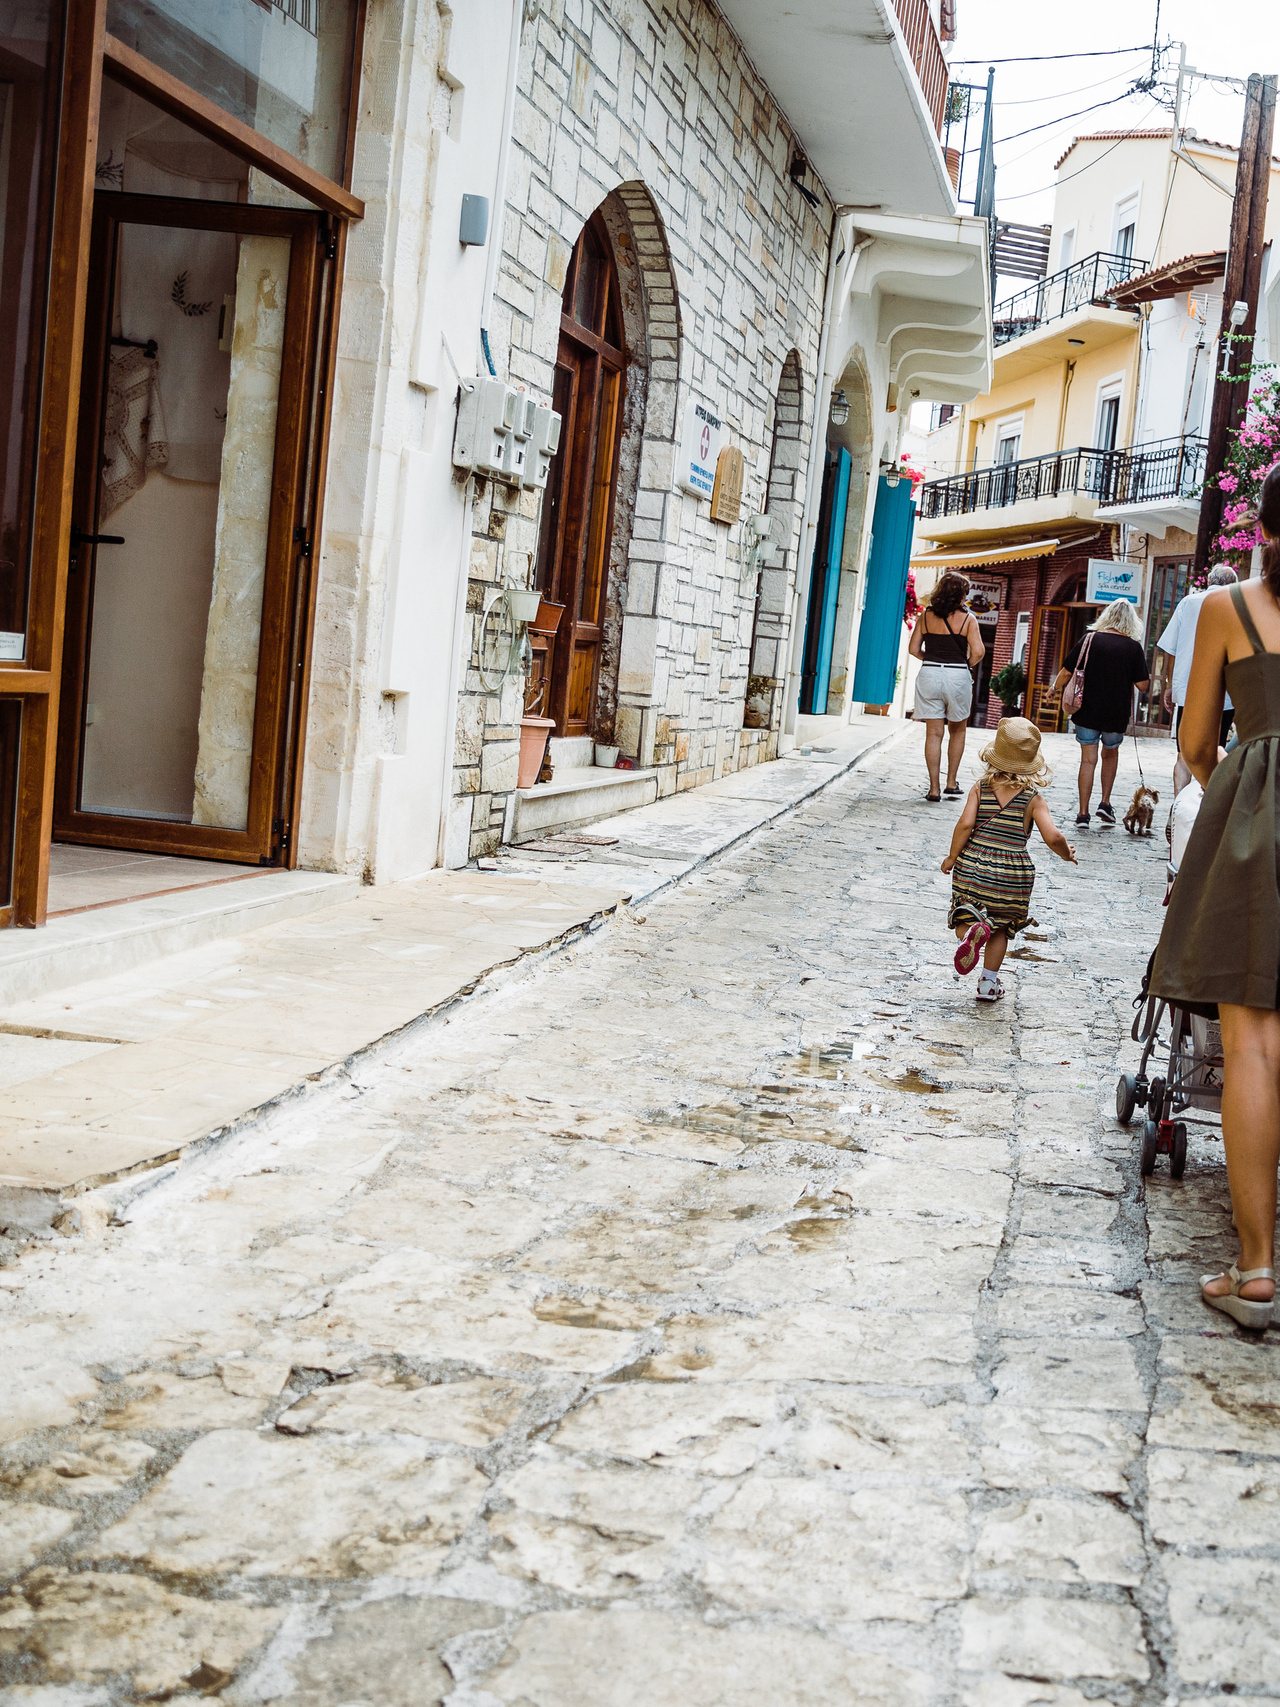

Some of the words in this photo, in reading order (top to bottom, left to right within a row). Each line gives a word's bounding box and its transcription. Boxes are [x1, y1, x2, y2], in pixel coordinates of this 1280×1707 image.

[1097, 571, 1117, 584] Fish
[970, 583, 999, 593] AKERY
[1097, 582, 1109, 590] spa
